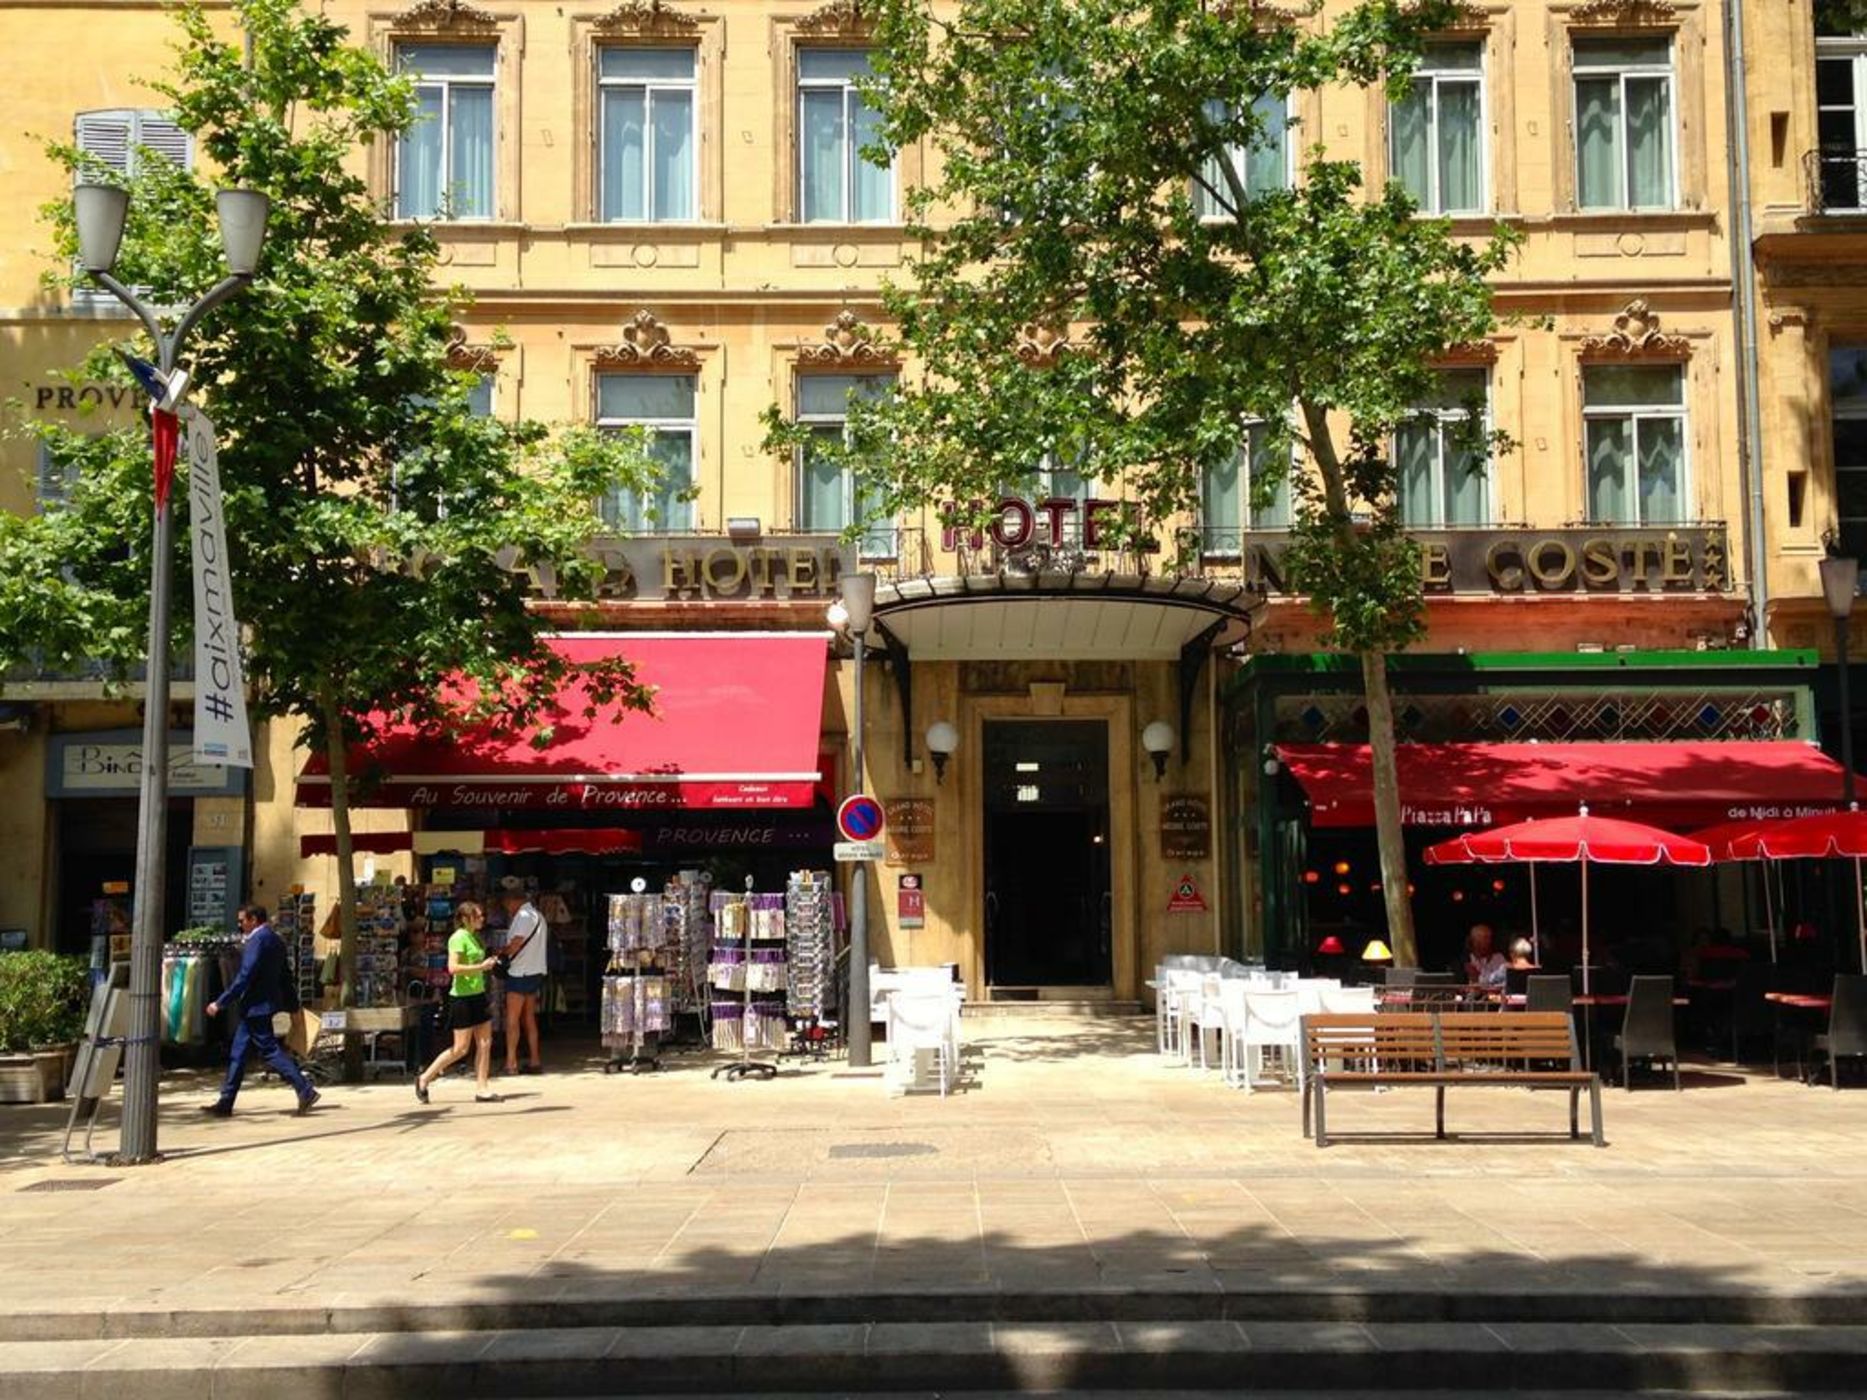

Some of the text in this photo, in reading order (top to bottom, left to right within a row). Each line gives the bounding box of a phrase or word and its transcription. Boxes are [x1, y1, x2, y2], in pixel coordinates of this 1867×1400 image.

[194, 431, 235, 723] #aixmaville
[411, 786, 438, 804] Au
[452, 785, 532, 804] Souvenir
[547, 787, 568, 803] de
[1401, 806, 1451, 824] Piazza
[1728, 807, 1747, 818] de
[1749, 807, 1780, 818] Midi
[656, 828, 776, 844] PROVENCE
